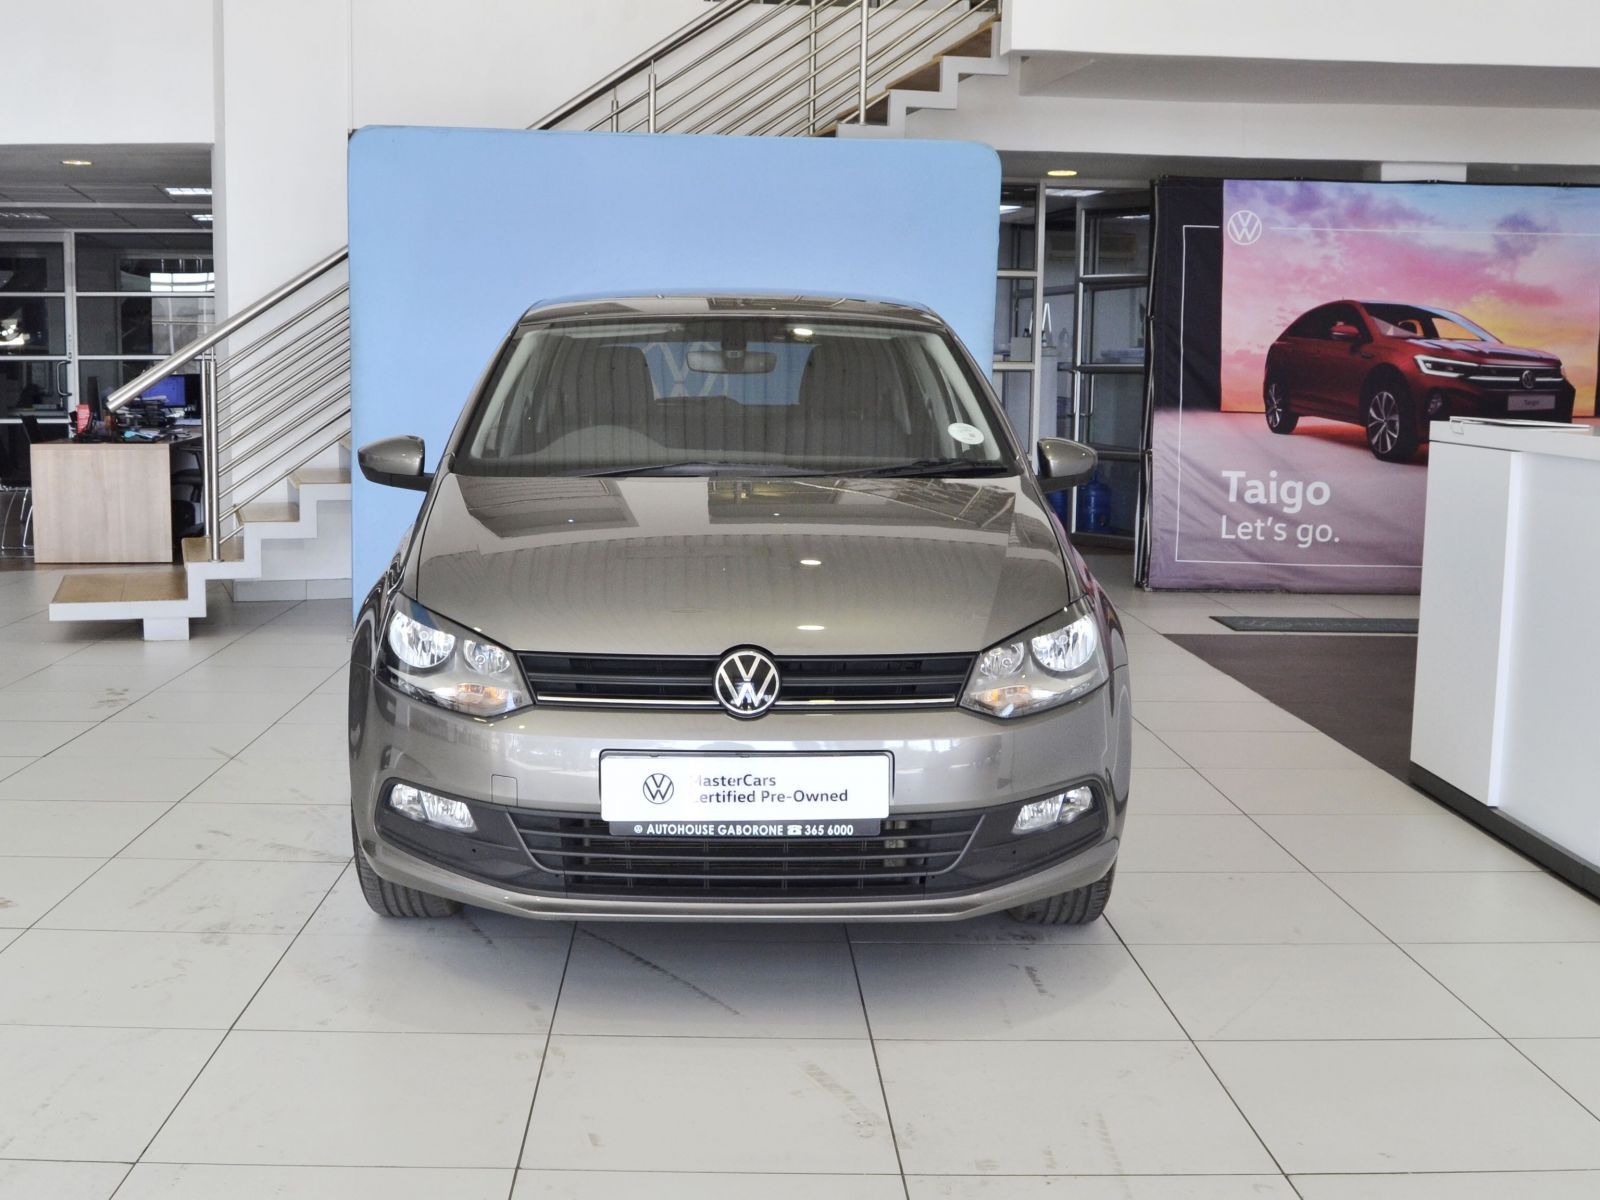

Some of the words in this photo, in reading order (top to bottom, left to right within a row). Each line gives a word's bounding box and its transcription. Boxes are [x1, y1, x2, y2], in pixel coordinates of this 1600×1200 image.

[1221, 470, 1331, 514] Taigo
[1221, 515, 1287, 541] Let's
[1296, 524, 1340, 548] go.
[715, 650, 779, 714] VW
[698, 790, 756, 803] ertified
[761, 789, 848, 803] Pre-Owned
[646, 824, 714, 835] AUTOHOUSE
[717, 825, 783, 836] GABORONE
[804, 824, 825, 836] 365
[827, 824, 854, 836] 6000
